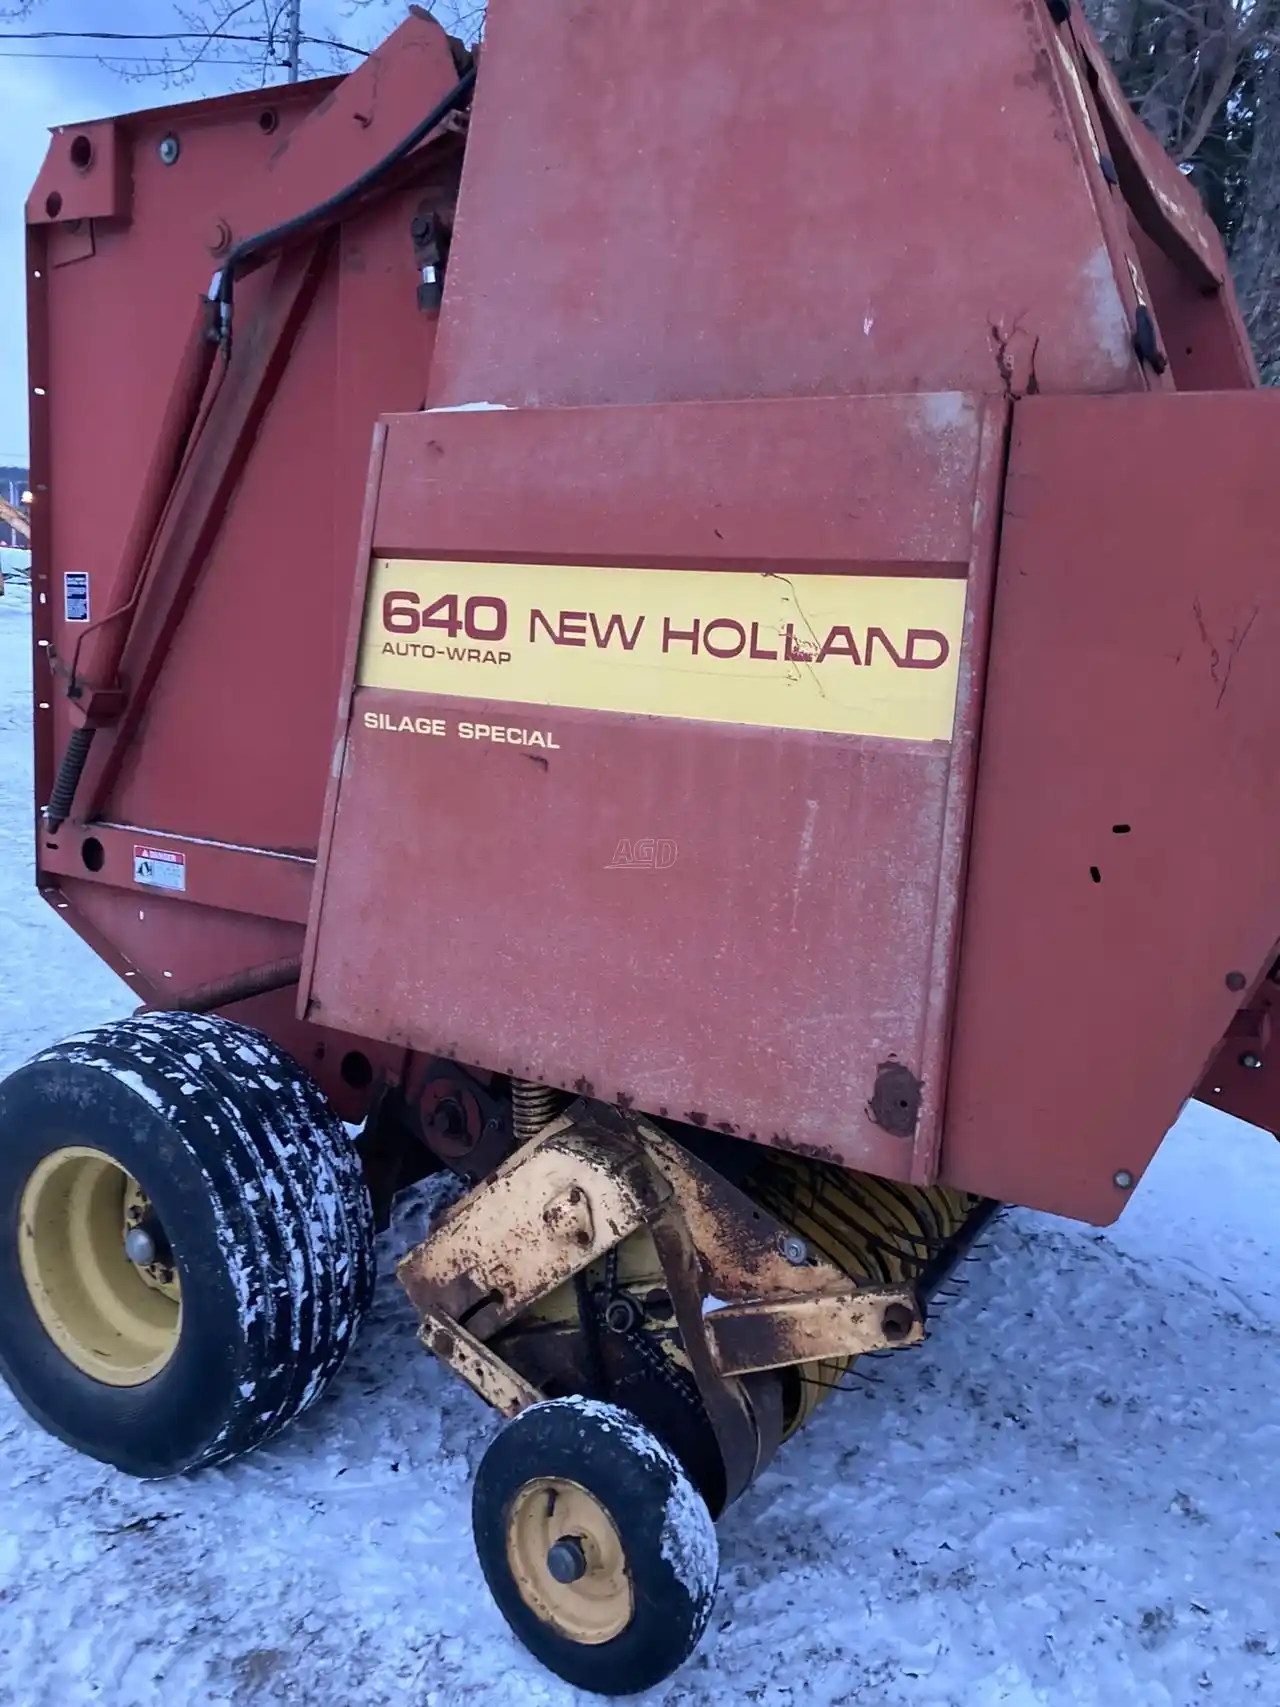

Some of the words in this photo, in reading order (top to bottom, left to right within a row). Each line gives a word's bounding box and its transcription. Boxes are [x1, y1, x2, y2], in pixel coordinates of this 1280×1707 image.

[382, 590, 508, 642] 640
[529, 608, 646, 651] NEW
[661, 616, 950, 669] HOLLAND
[382, 642, 511, 665] AUTO-WRAP
[363, 711, 446, 737] SILAGE
[458, 722, 560, 749] SPECIAL
